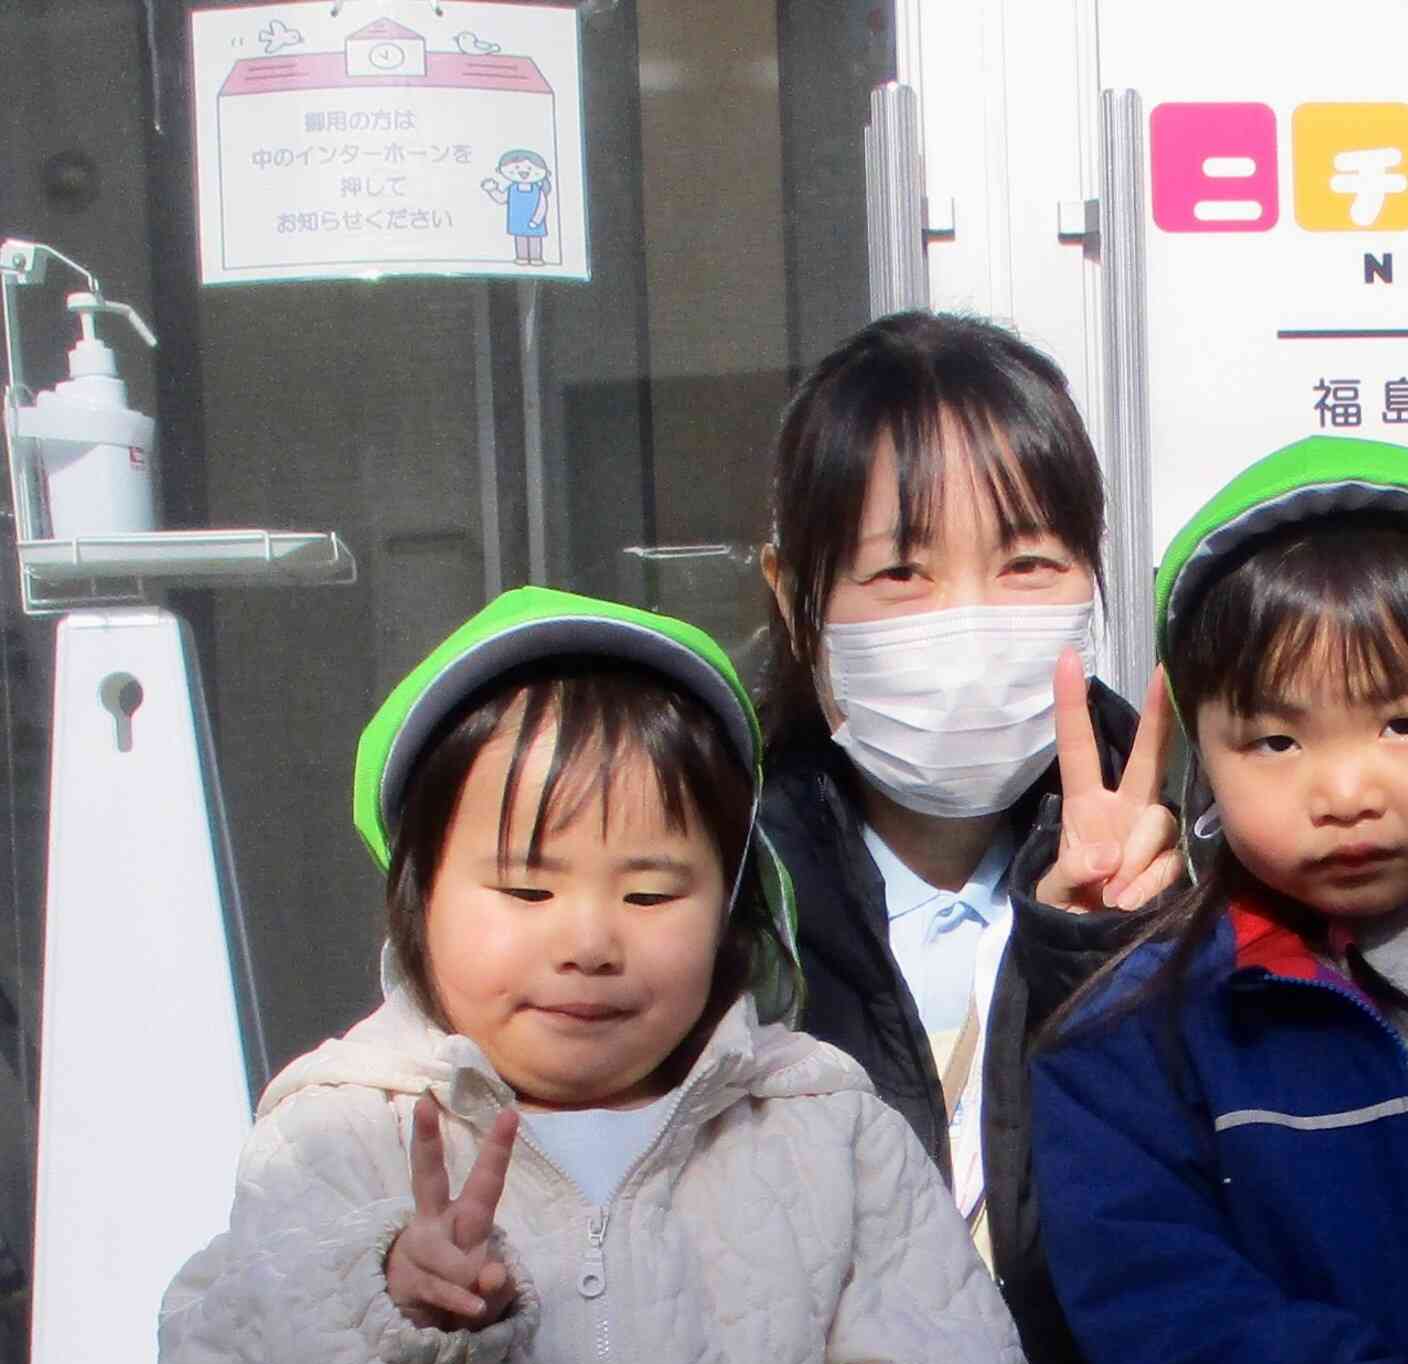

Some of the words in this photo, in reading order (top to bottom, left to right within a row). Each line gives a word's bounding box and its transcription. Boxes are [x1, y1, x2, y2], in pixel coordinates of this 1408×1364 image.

[304, 109, 417, 133] 御用の方は
[341, 176, 407, 198] 押して
[277, 208, 455, 233] お知らせください
